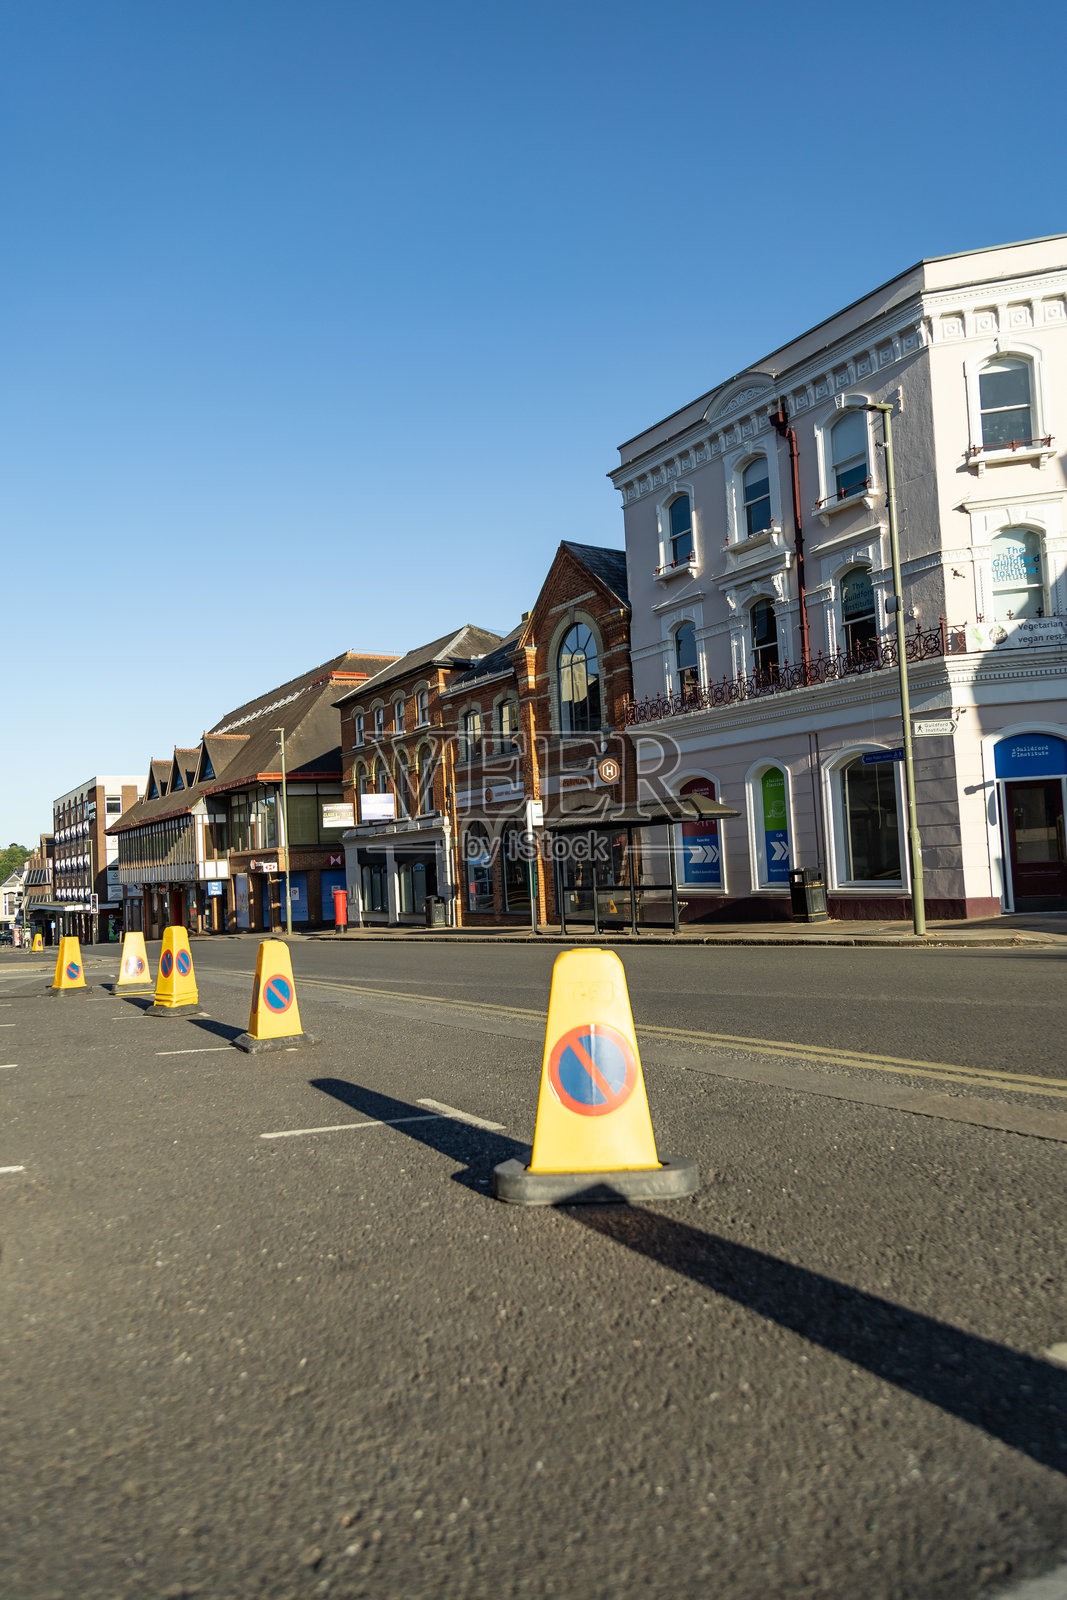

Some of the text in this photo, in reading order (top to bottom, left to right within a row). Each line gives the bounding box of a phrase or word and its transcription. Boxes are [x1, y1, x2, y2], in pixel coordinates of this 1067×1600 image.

[1006, 546, 1025, 554] The
[992, 554, 1040, 567] Guildford
[995, 567, 1038, 577] Institute
[852, 581, 865, 590] The
[1018, 620, 1063, 631] Vegetarian
[1018, 635, 1044, 644] vegan
